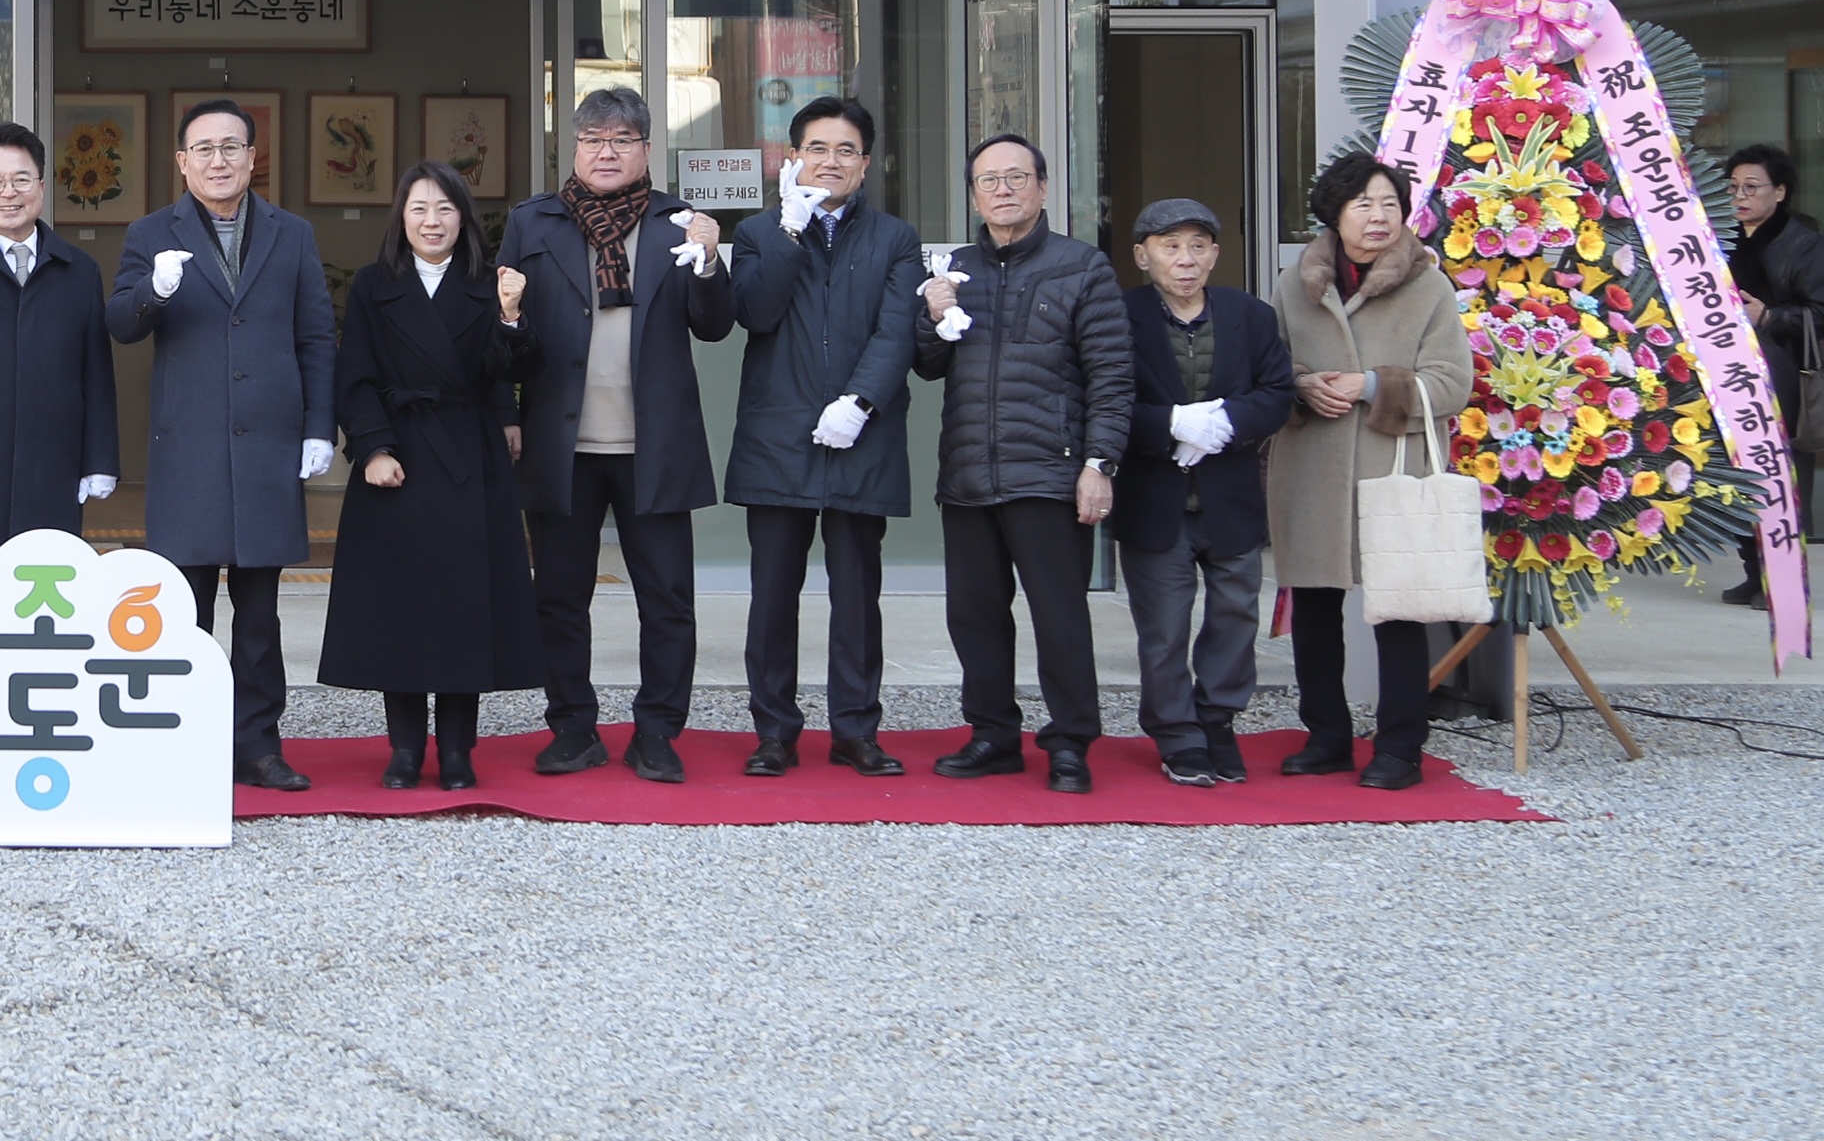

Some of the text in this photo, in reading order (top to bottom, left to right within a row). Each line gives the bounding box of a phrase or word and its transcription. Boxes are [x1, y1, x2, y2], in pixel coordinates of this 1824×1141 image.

[688, 159, 752, 173] 뒤로 한걸음
[683, 187, 759, 200] 물러나 주세요
[1621, 111, 1690, 222] 조운동
[1668, 233, 1736, 348] 개청을
